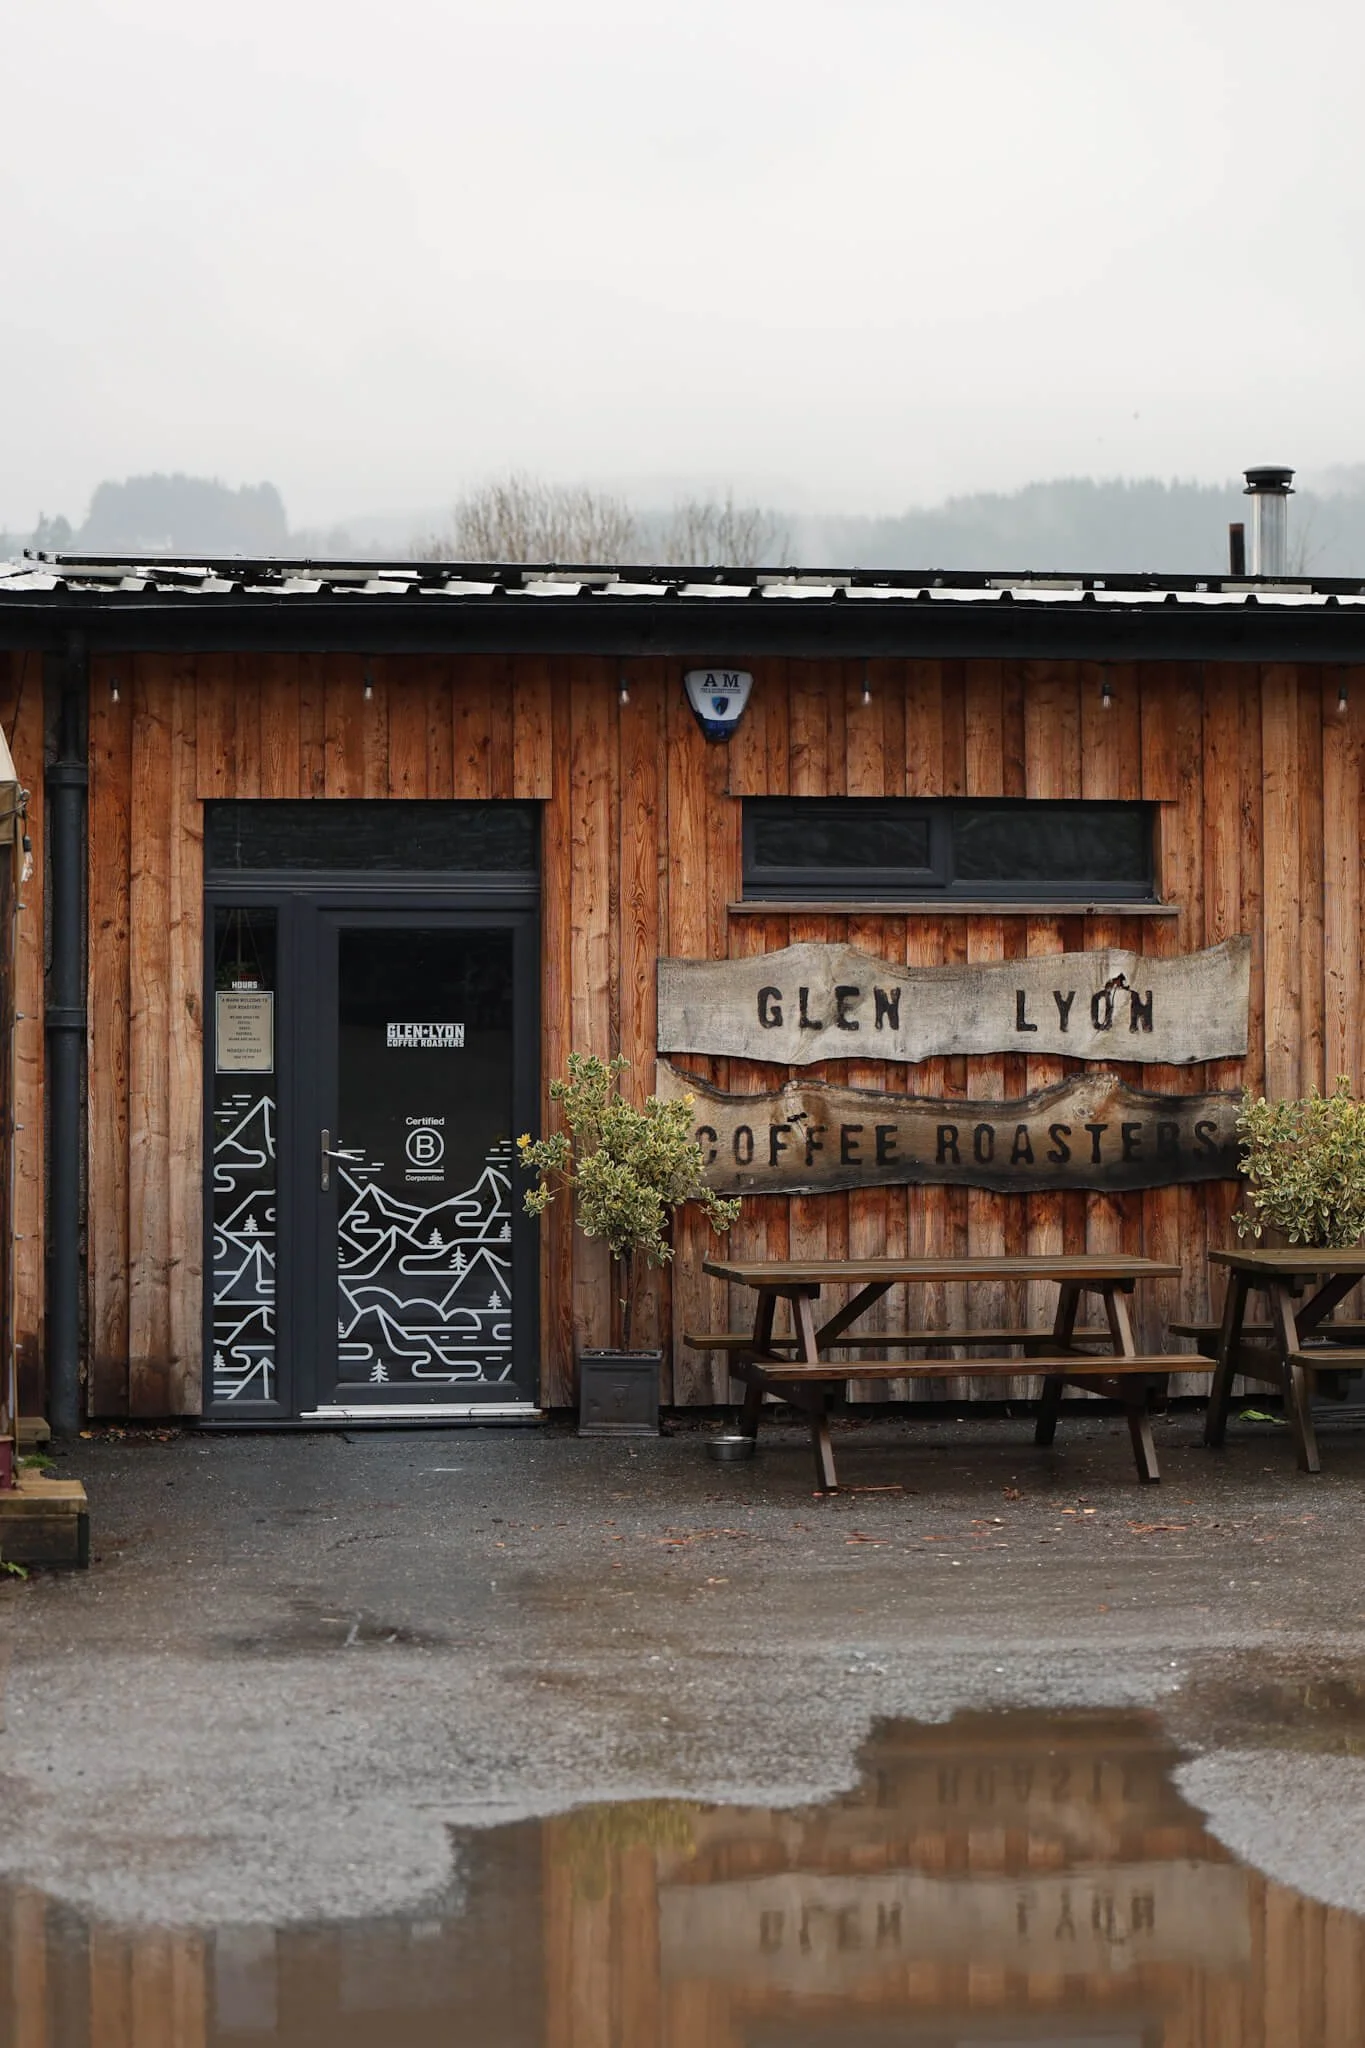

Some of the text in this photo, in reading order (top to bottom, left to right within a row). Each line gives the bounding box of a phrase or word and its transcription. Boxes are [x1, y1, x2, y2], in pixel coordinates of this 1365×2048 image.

[231, 980, 258, 989] HOURS
[756, 985, 1154, 1034] GLEN LYON
[387, 1024, 465, 1038] GLEN LYON
[387, 1039, 465, 1048] COFFEE ROASTERS
[405, 1117, 445, 1126] Certified
[416, 1135, 435, 1159] B
[696, 1120, 1220, 1167] COFFEE ROASTERS
[405, 1174, 445, 1182] Corporation
